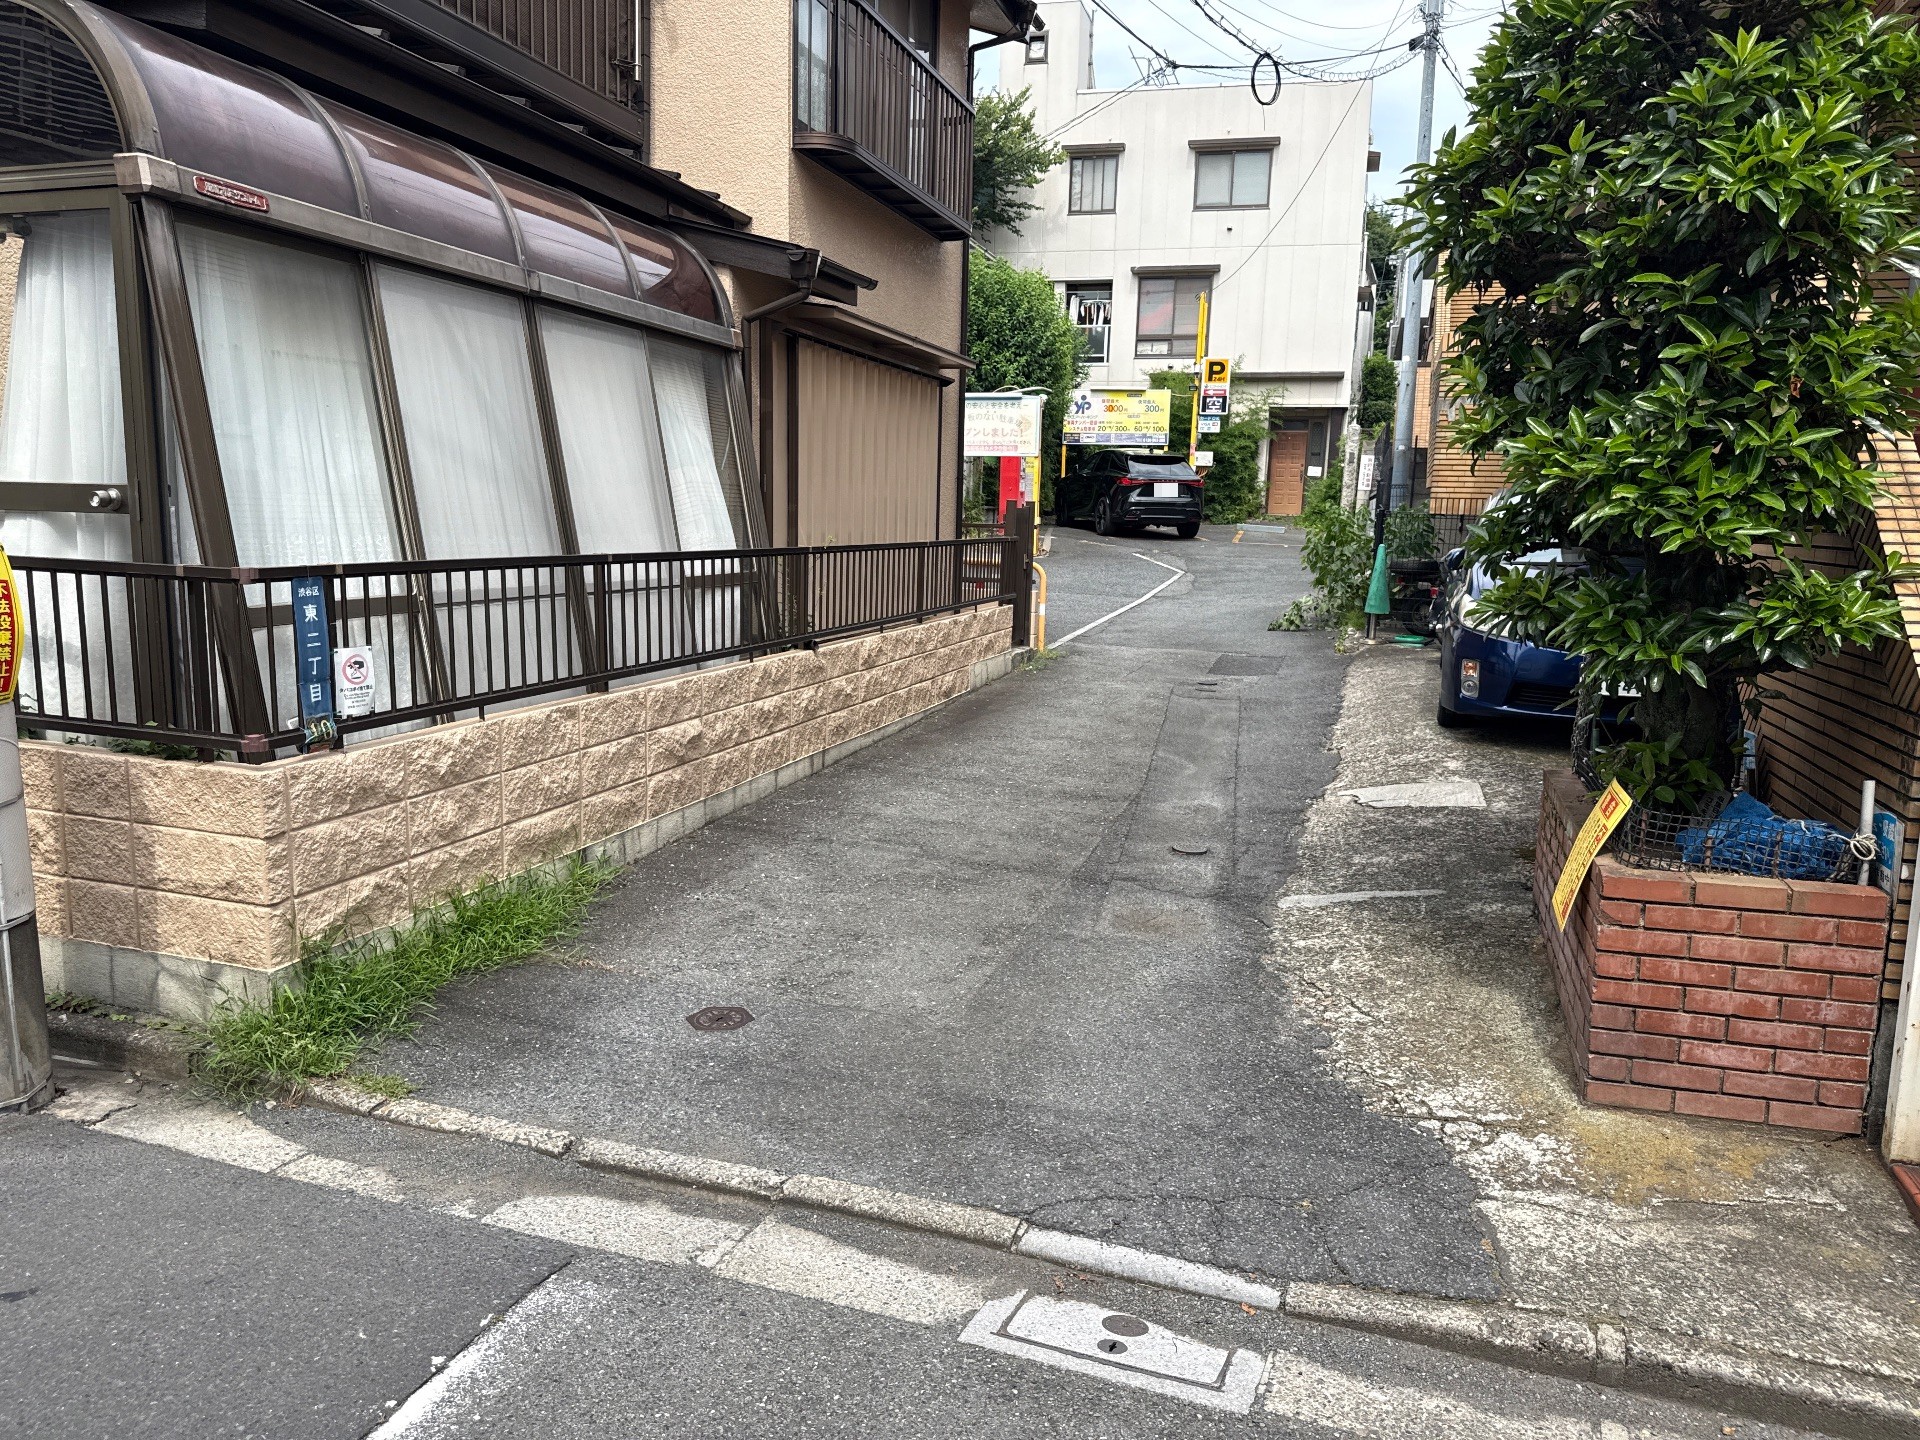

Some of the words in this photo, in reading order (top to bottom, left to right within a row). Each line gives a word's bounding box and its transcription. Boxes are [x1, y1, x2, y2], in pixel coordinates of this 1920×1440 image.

[1208, 362, 1225, 381] P
[298, 586, 320, 598] 渋谷区
[303, 604, 322, 702] 東二丁目
